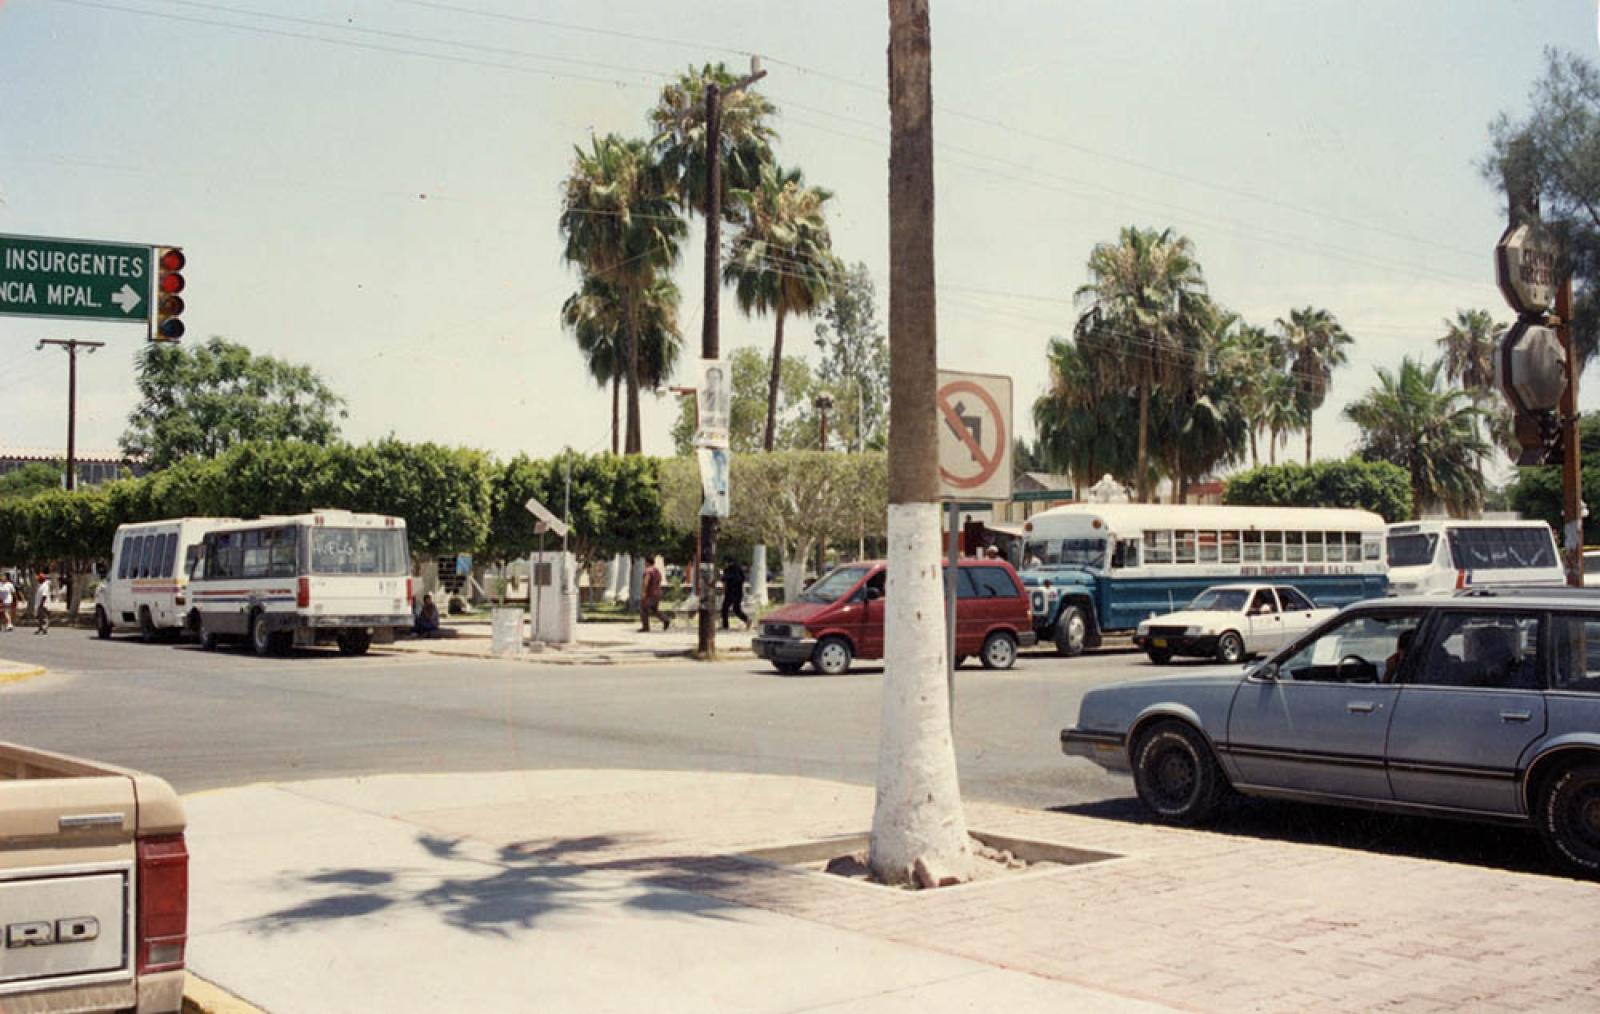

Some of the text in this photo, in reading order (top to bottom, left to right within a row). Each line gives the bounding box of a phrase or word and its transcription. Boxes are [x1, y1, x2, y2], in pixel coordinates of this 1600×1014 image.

[5, 247, 144, 279] INSURGENTES
[47, 284, 102, 308] MPAL.
[0, 916, 100, 949] RD
